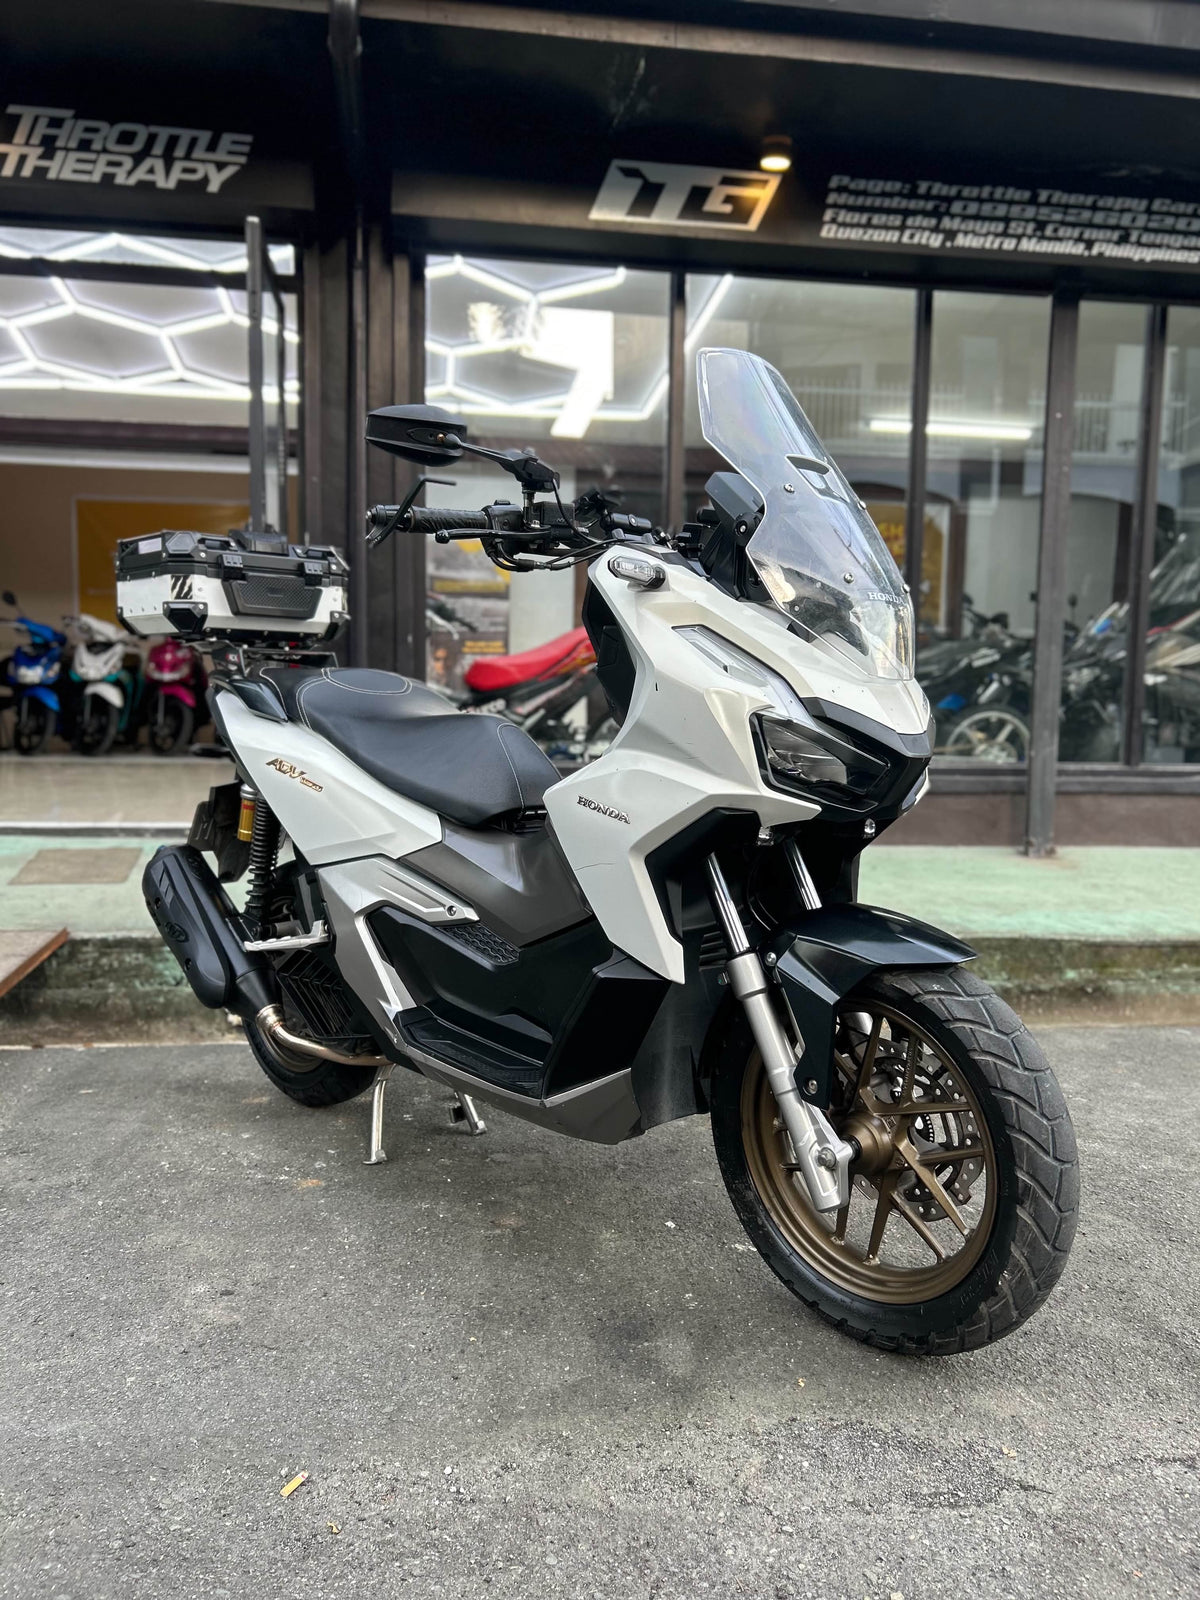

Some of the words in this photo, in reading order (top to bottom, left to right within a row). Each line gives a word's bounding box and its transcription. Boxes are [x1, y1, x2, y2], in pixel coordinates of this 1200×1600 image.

[5, 103, 254, 164] THROTTLE
[0, 142, 242, 194] THERAPY
[827, 174, 912, 194] Page:
[915, 180, 1032, 202] Throttle
[1035, 188, 1149, 212] Therapy
[1150, 197, 1200, 216] Gar
[819, 223, 900, 244] Quezon
[822, 207, 904, 228] Flores
[904, 214, 938, 229] de
[939, 215, 1005, 235] Mayo
[867, 591, 908, 606] HONDA
[265, 757, 307, 779] ADV
[576, 795, 631, 825] HONDA
